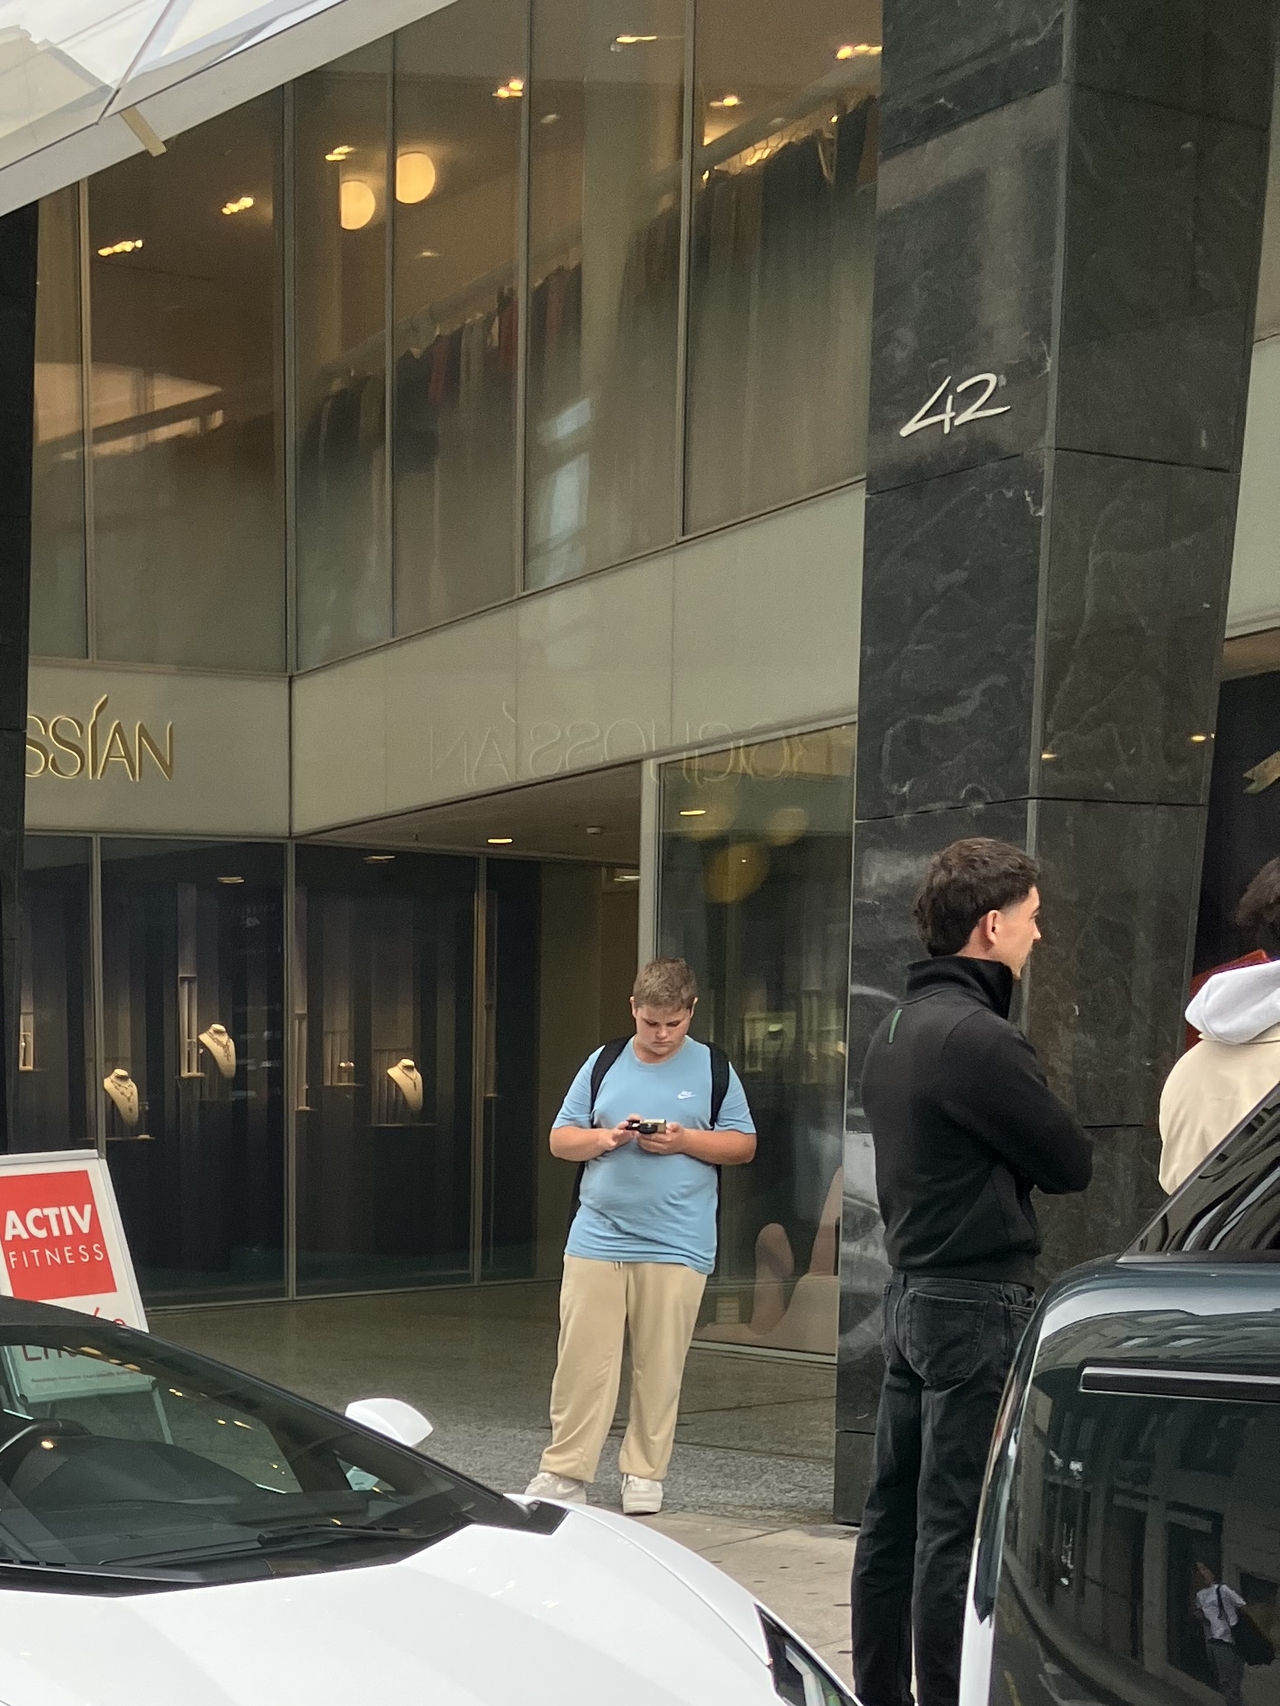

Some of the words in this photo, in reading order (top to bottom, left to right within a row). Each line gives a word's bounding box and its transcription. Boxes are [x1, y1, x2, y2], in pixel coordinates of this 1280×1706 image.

[899, 373, 1011, 437] 42
[4, 1203, 92, 1241] ACTIV
[8, 1243, 104, 1270] FITNESS
